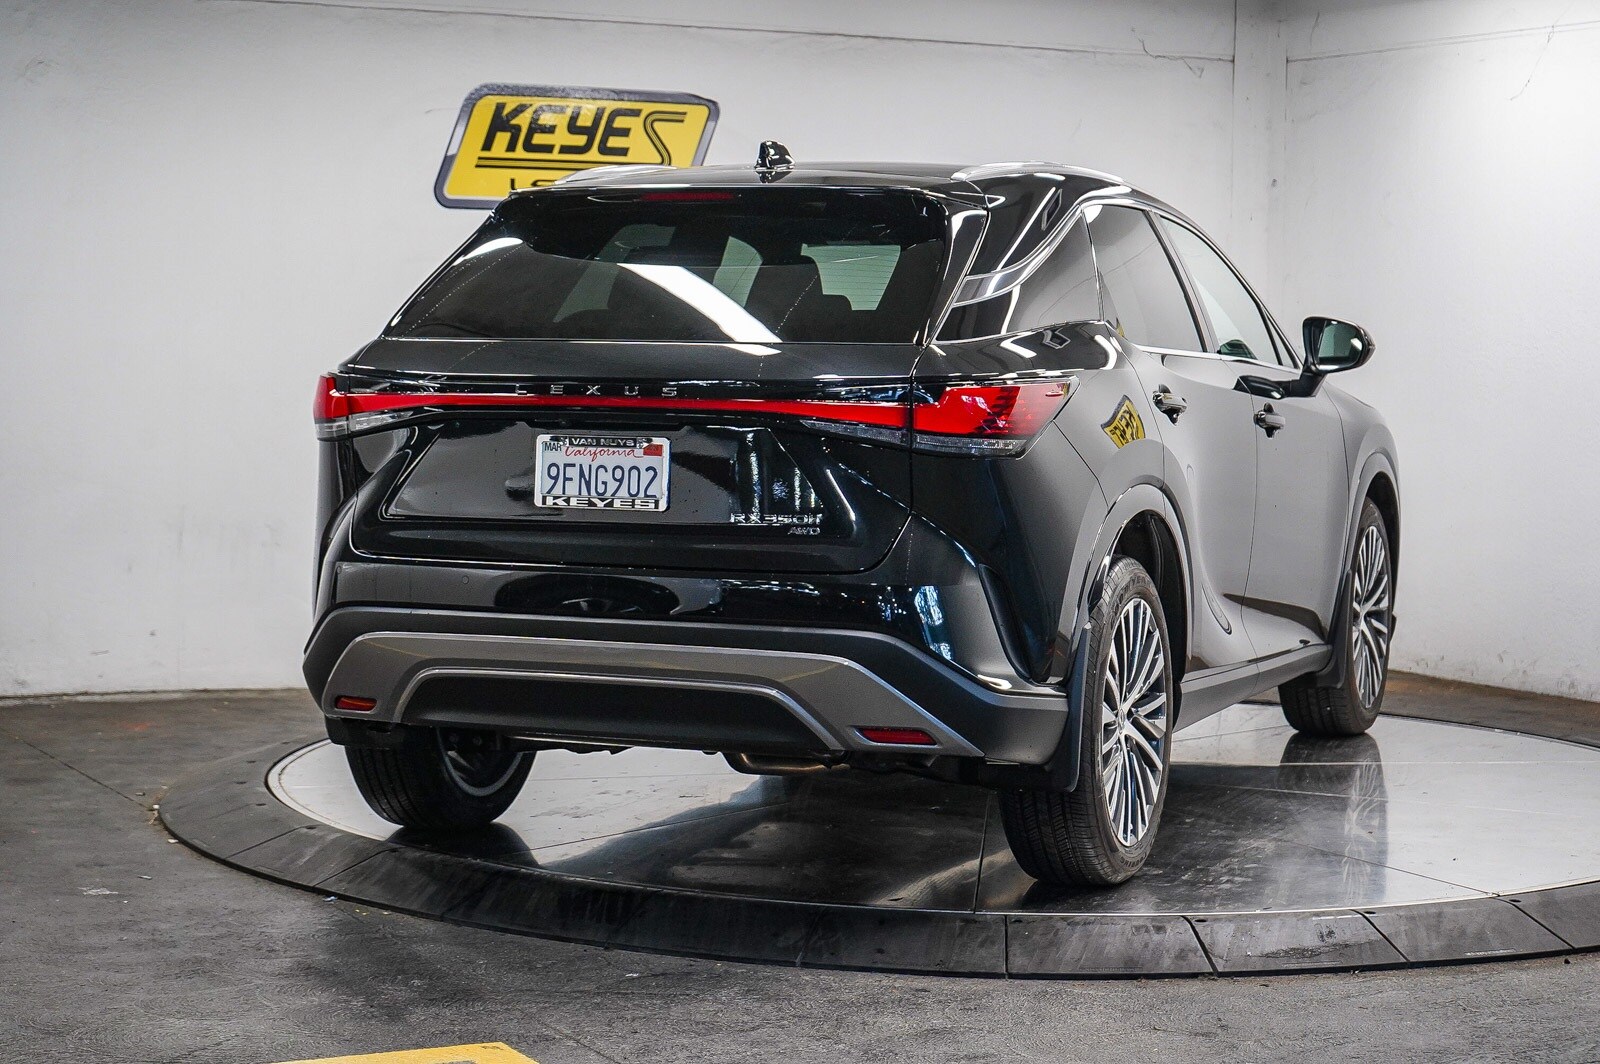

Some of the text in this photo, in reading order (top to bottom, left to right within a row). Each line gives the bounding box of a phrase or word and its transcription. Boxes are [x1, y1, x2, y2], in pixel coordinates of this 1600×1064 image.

[480, 102, 687, 166] KEYES
[515, 384, 677, 397] LEXUS
[544, 442, 562, 452] MAR
[571, 438, 634, 447] VAN NUYS
[565, 447, 643, 462] California
[546, 463, 658, 498] 9FNG902
[546, 496, 655, 509] KEYES
[788, 527, 820, 535] AWD
